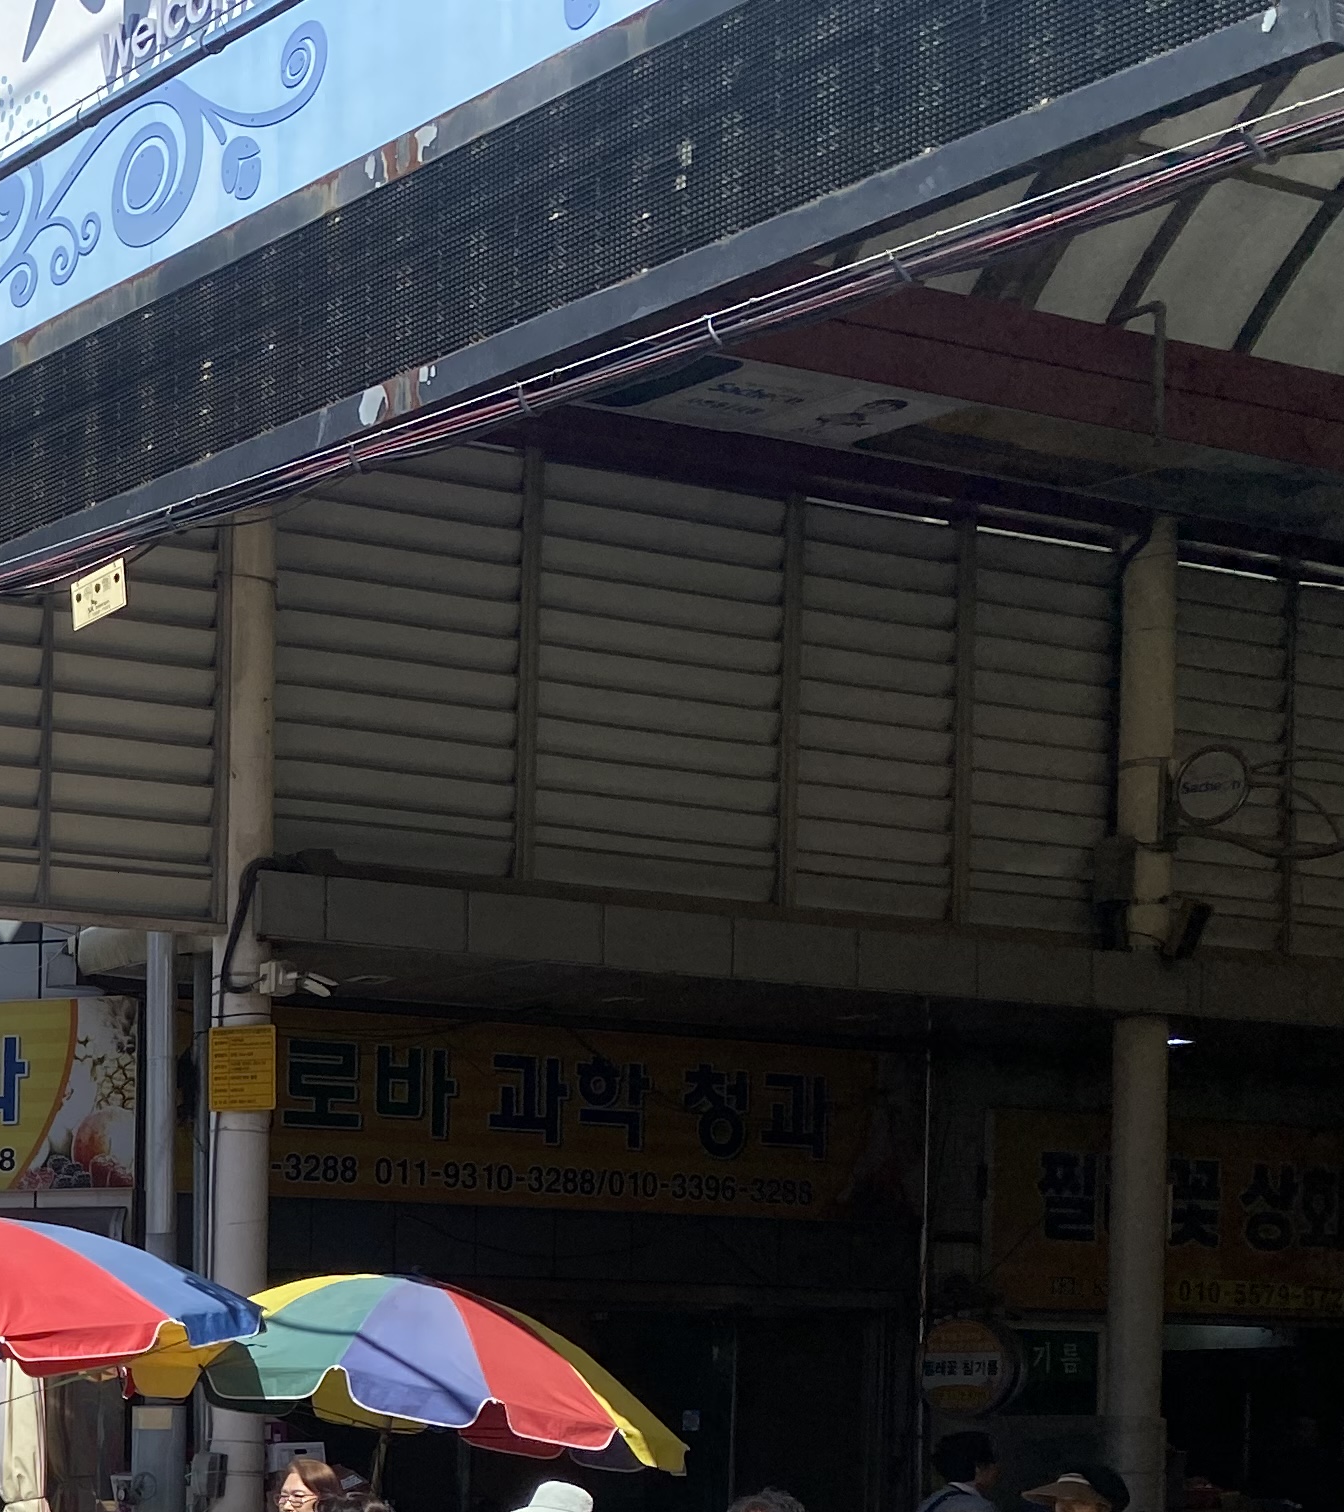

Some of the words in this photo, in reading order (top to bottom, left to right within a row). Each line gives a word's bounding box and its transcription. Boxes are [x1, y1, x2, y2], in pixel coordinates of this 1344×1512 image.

[280, 1038, 459, 1141] 로바
[488, 1051, 651, 1151] 과학
[682, 1062, 833, 1162] 청과
[1032, 1341, 1081, 1375] 기름
